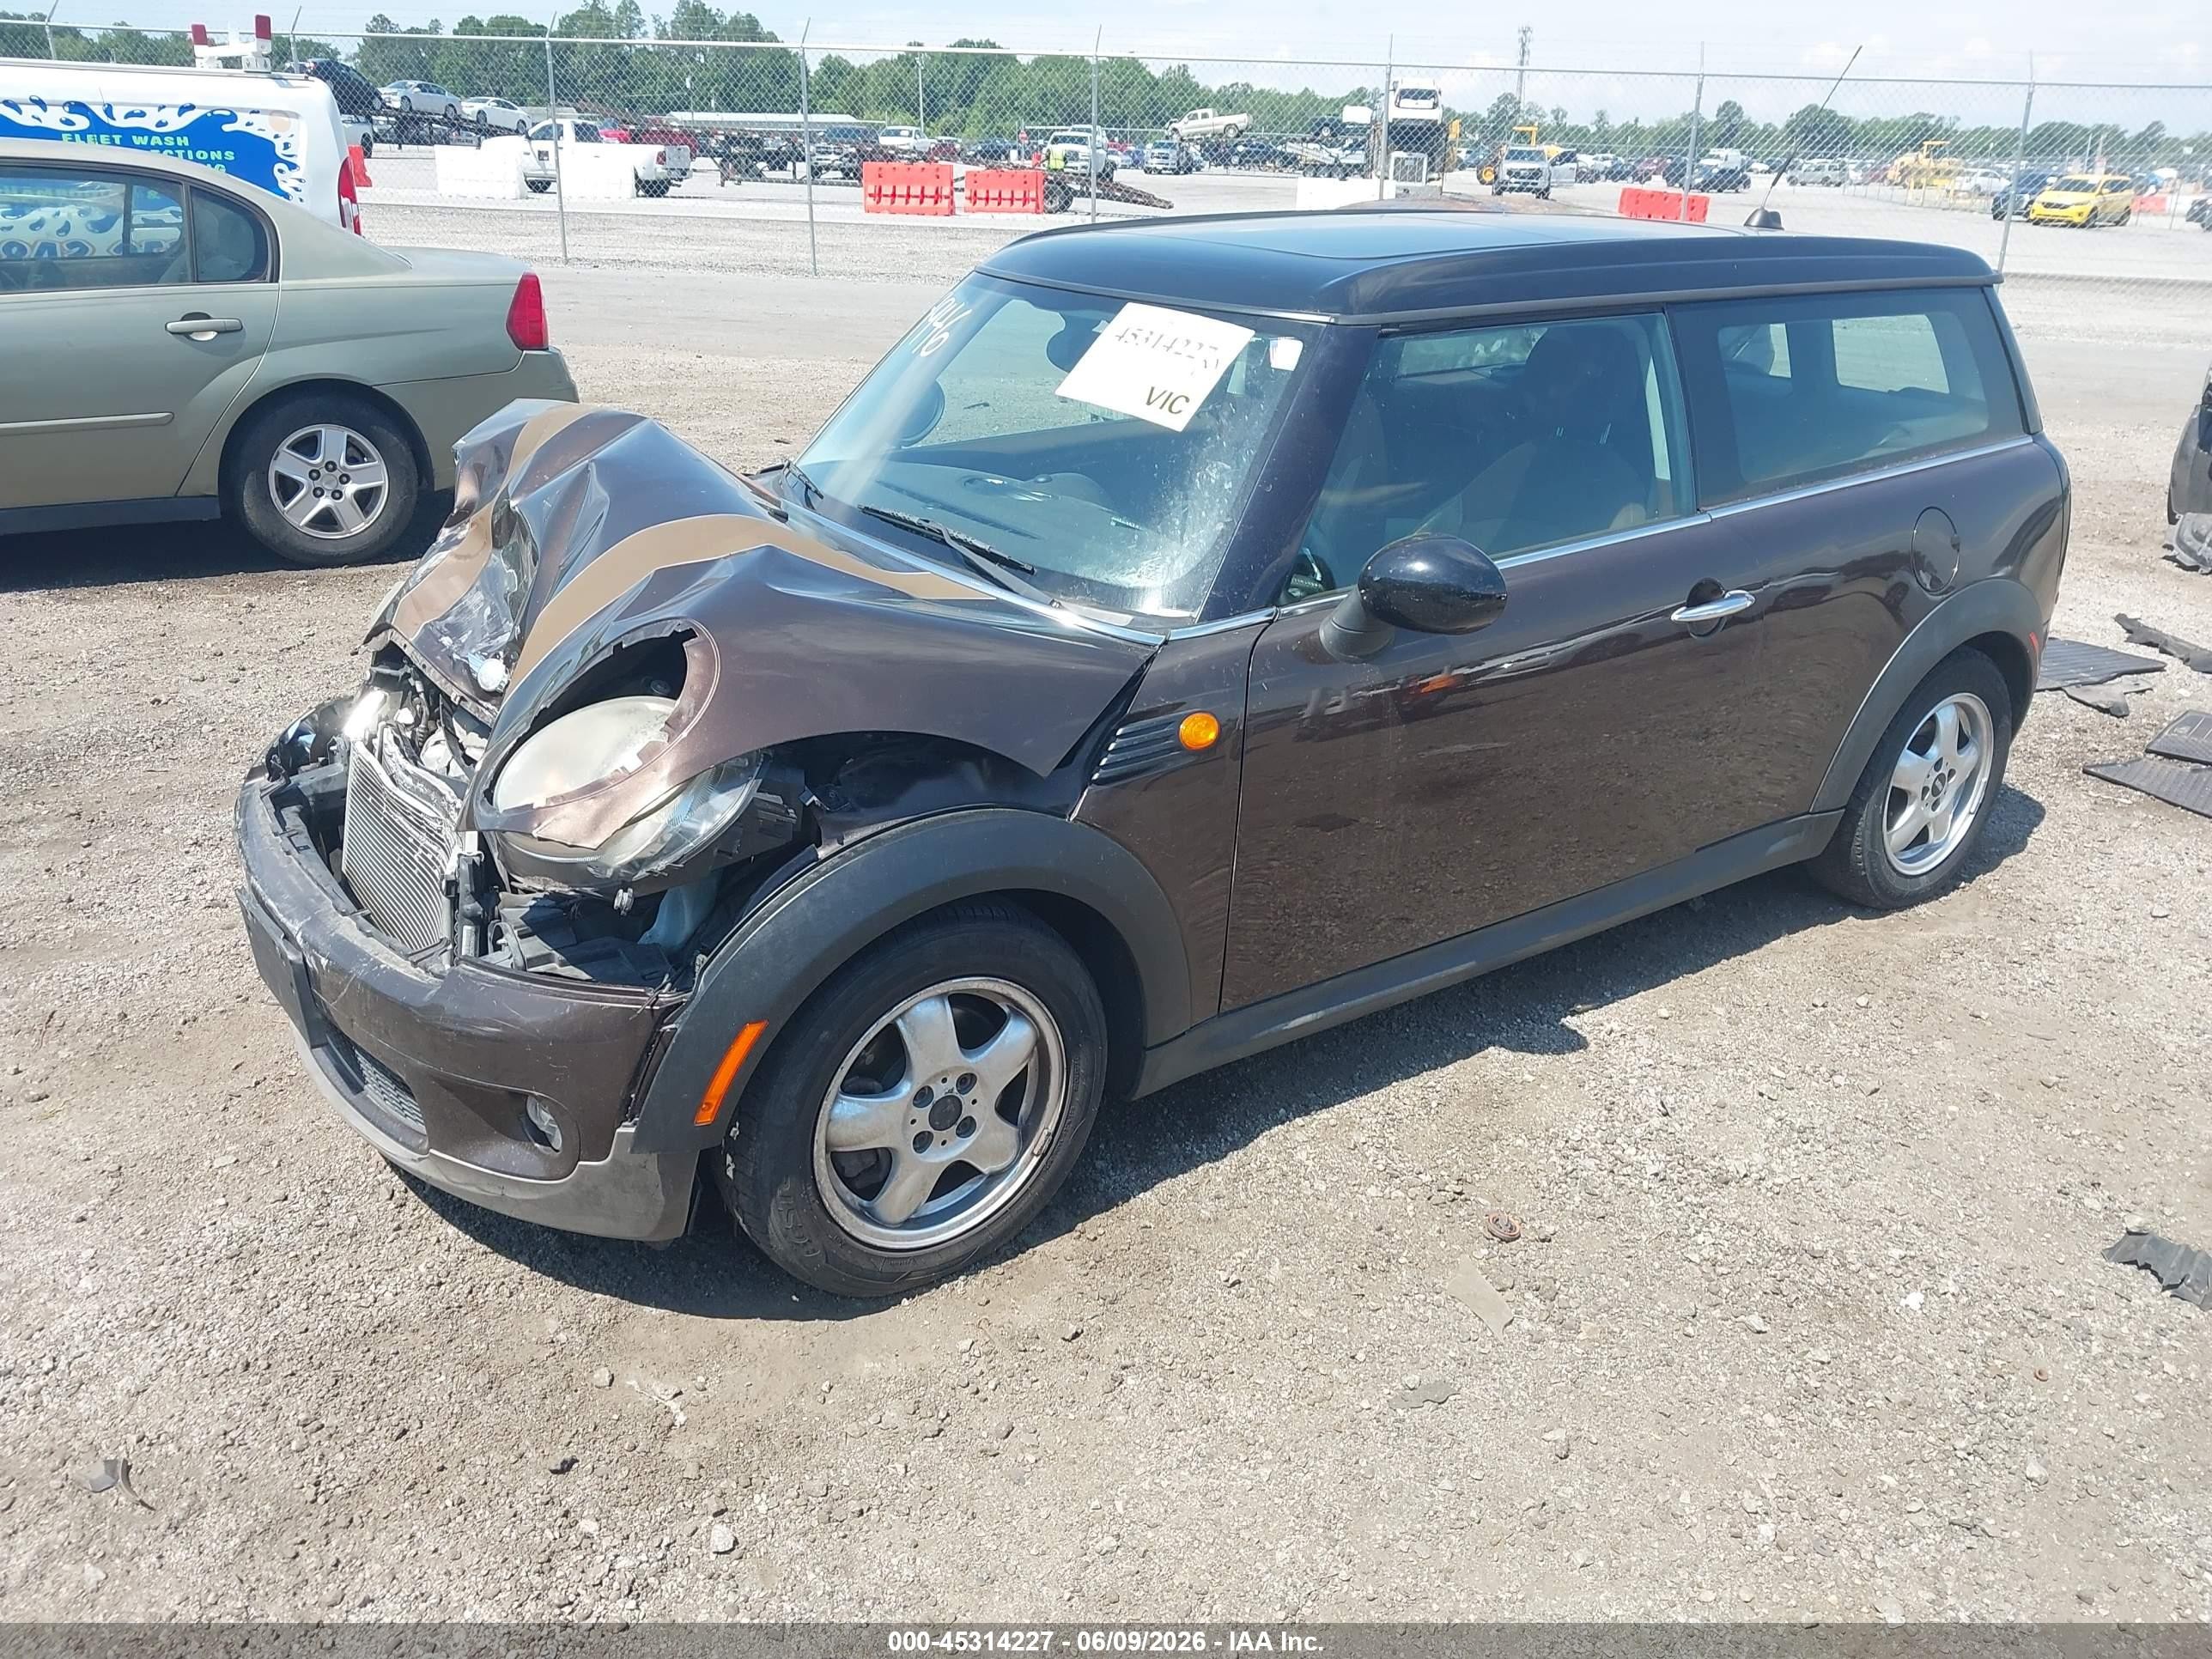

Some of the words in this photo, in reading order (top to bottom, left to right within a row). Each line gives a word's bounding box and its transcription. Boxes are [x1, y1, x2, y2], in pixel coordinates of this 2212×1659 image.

[61, 133, 123, 145] FLEET
[131, 135, 189, 147] WASH
[149, 149, 235, 161] CTIONS
[1145, 386, 1190, 415] VIC
